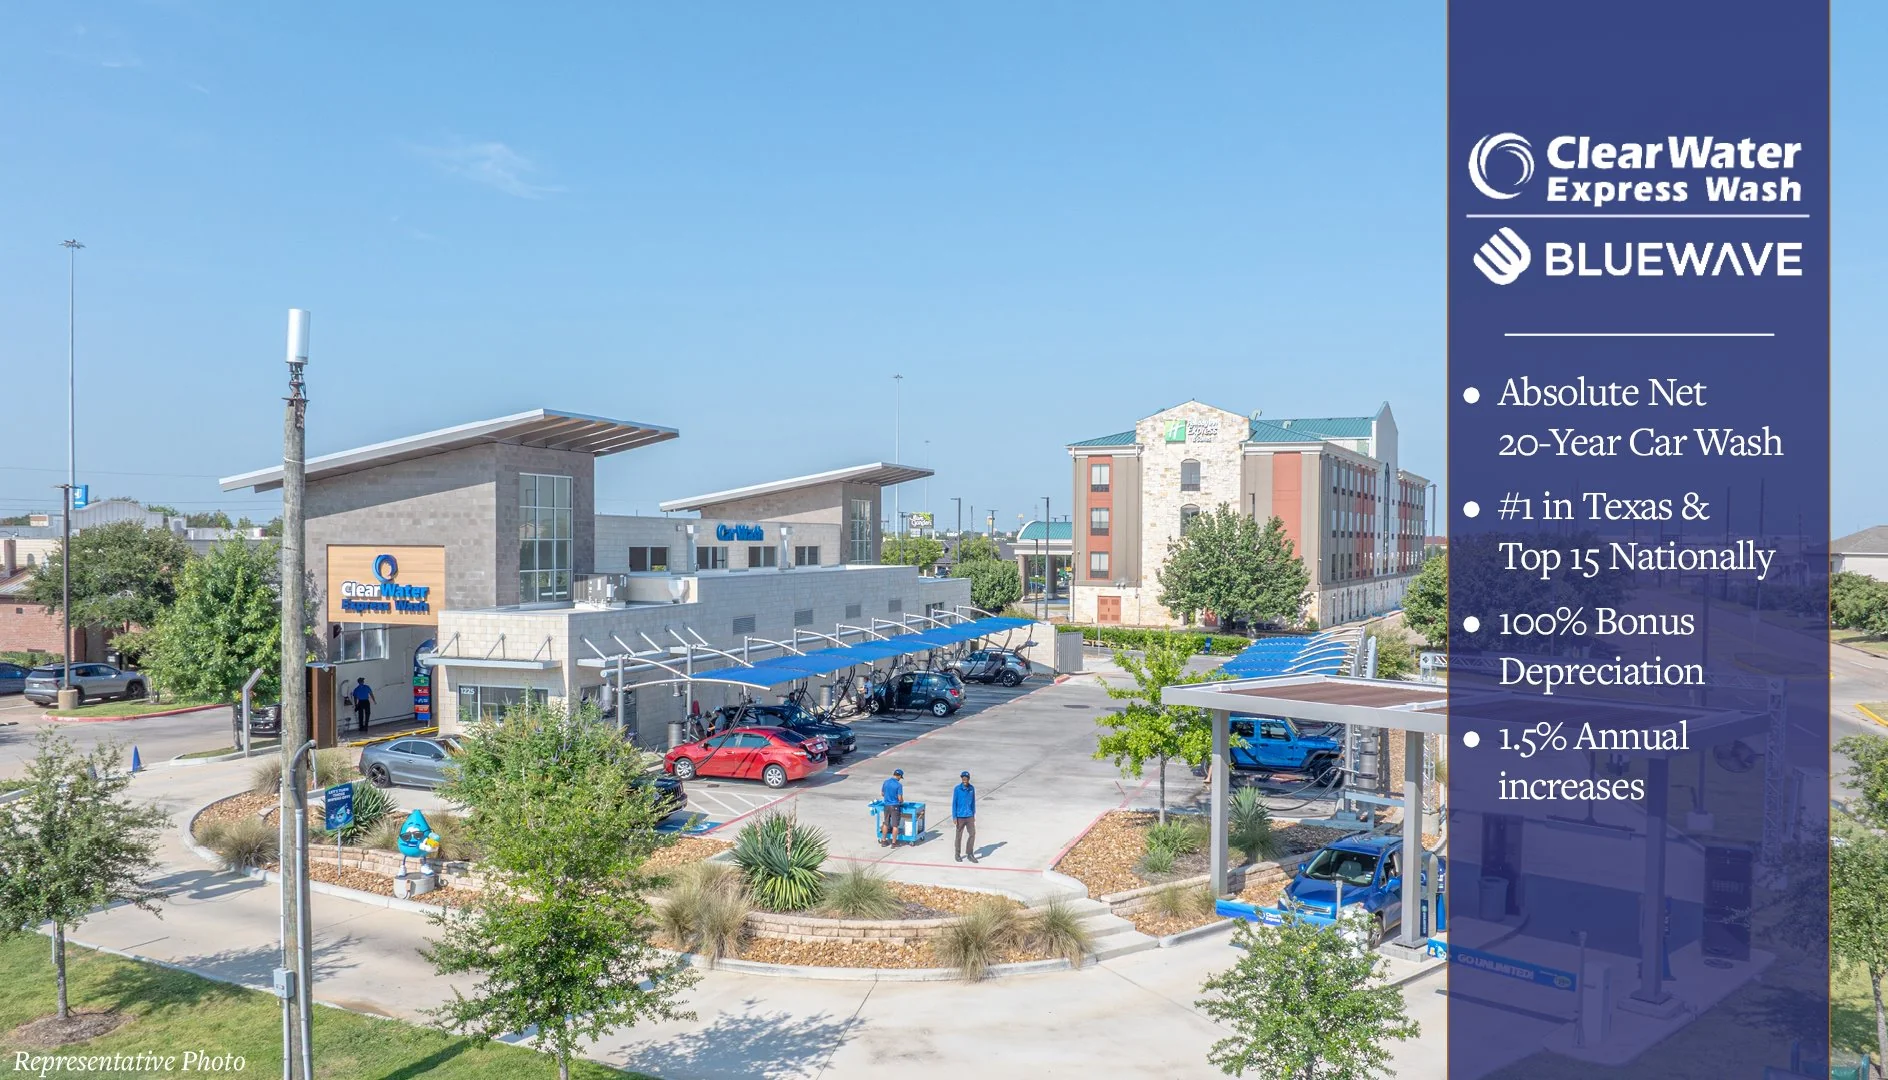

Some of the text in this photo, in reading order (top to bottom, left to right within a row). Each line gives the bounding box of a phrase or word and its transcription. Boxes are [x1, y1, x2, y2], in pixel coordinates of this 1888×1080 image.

[1188, 428, 1218, 436] Express
[342, 599, 429, 613] Express Wash
[460, 687, 475, 695] 1225
[1457, 953, 1474, 964] GO
